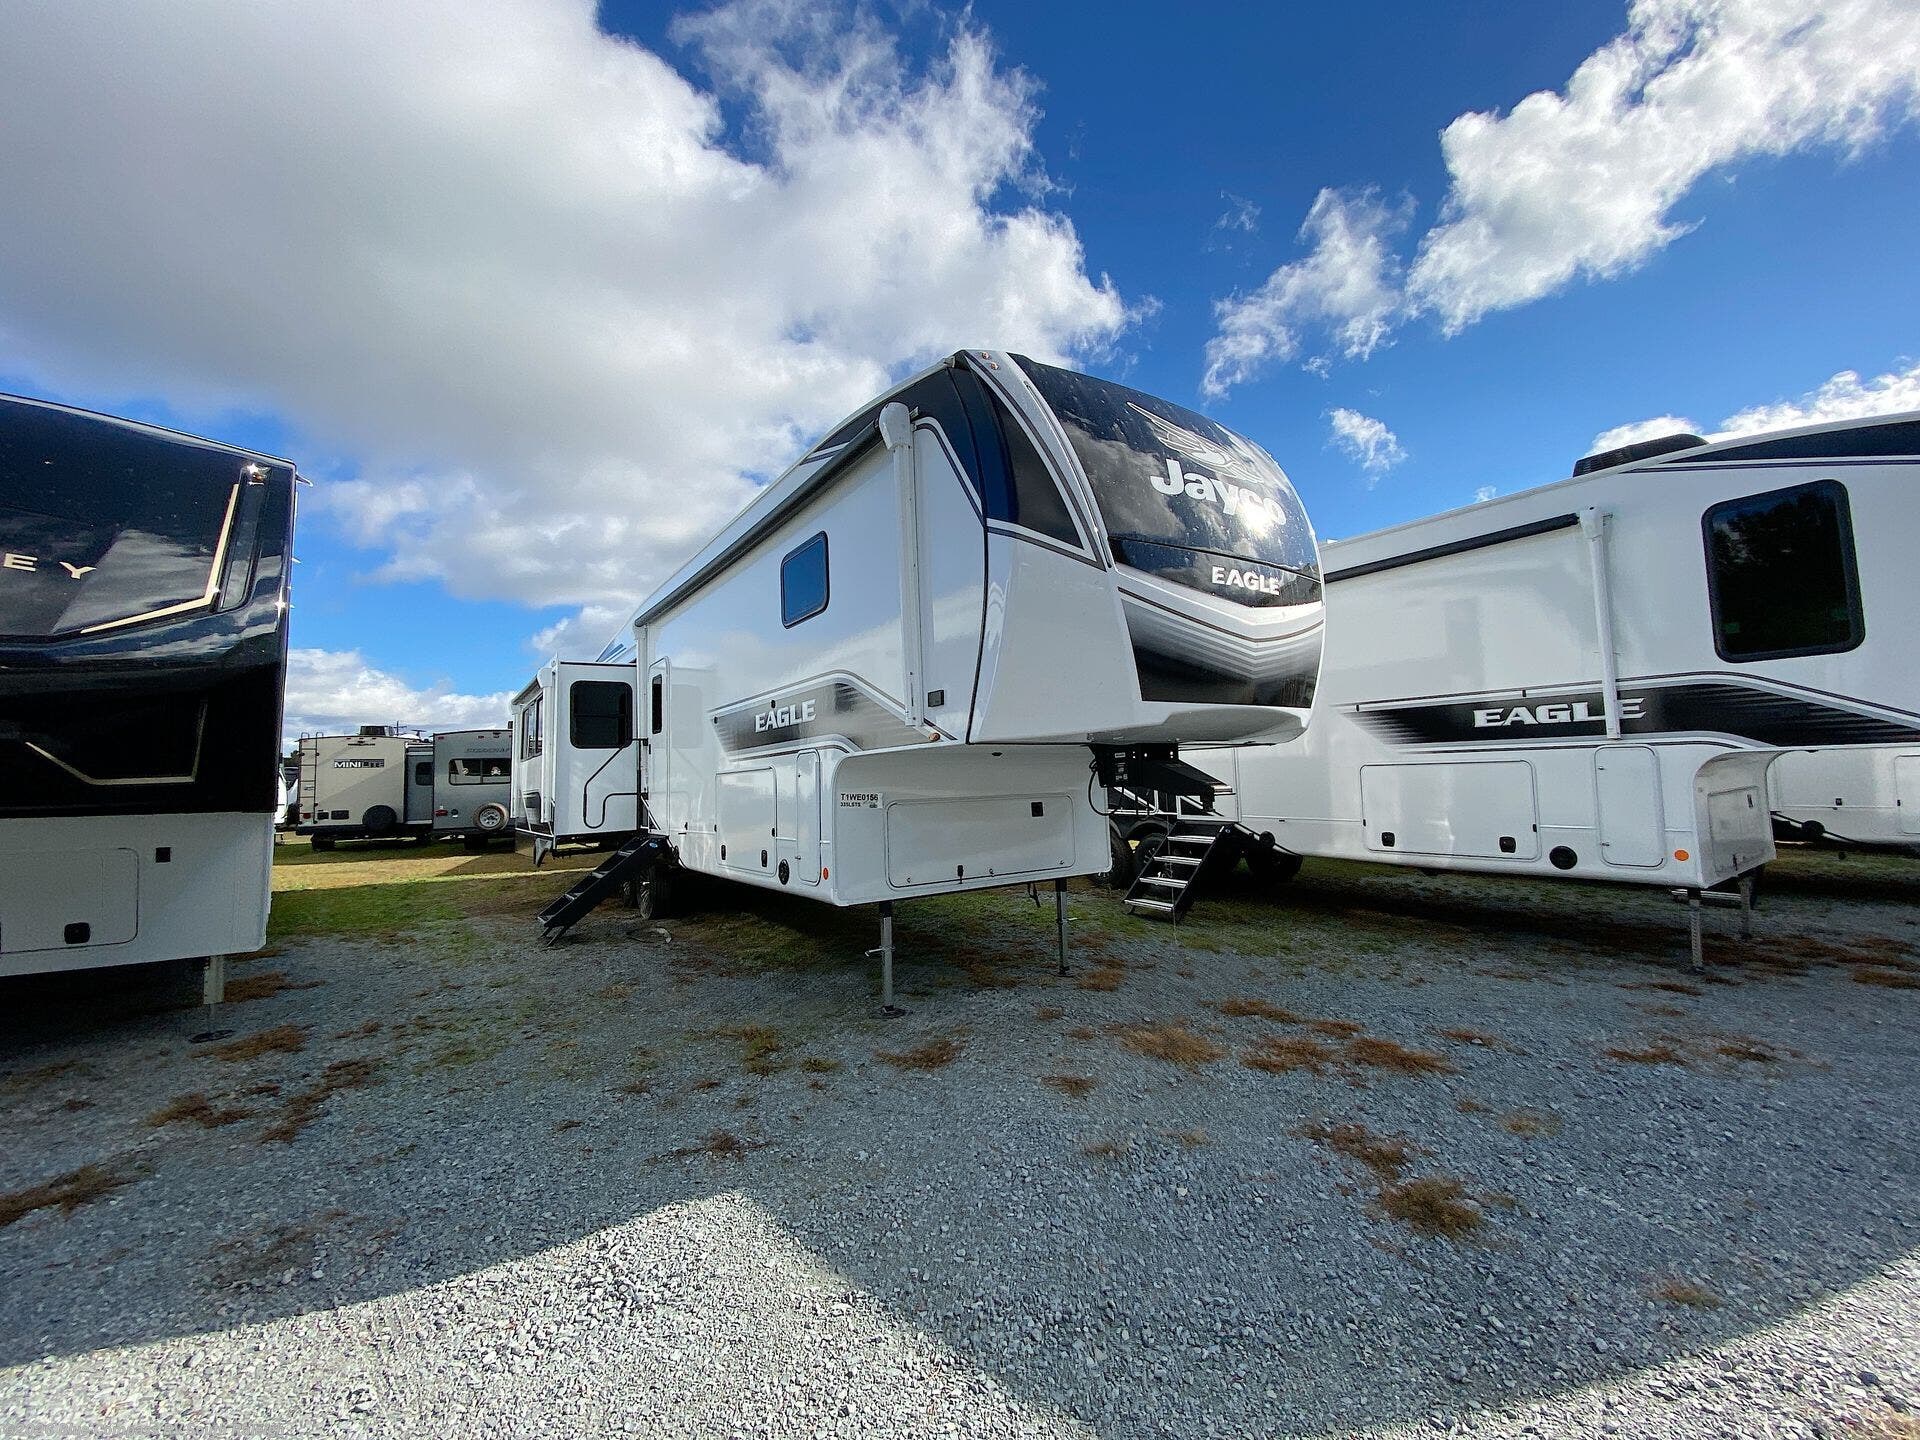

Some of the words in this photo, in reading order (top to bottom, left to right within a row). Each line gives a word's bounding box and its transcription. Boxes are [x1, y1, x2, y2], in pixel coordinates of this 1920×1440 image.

[1150, 459, 1287, 526] Jayco
[1212, 566, 1281, 595] EAGLE
[755, 699, 817, 733] EAGLE
[1473, 697, 1647, 728] EAGLE
